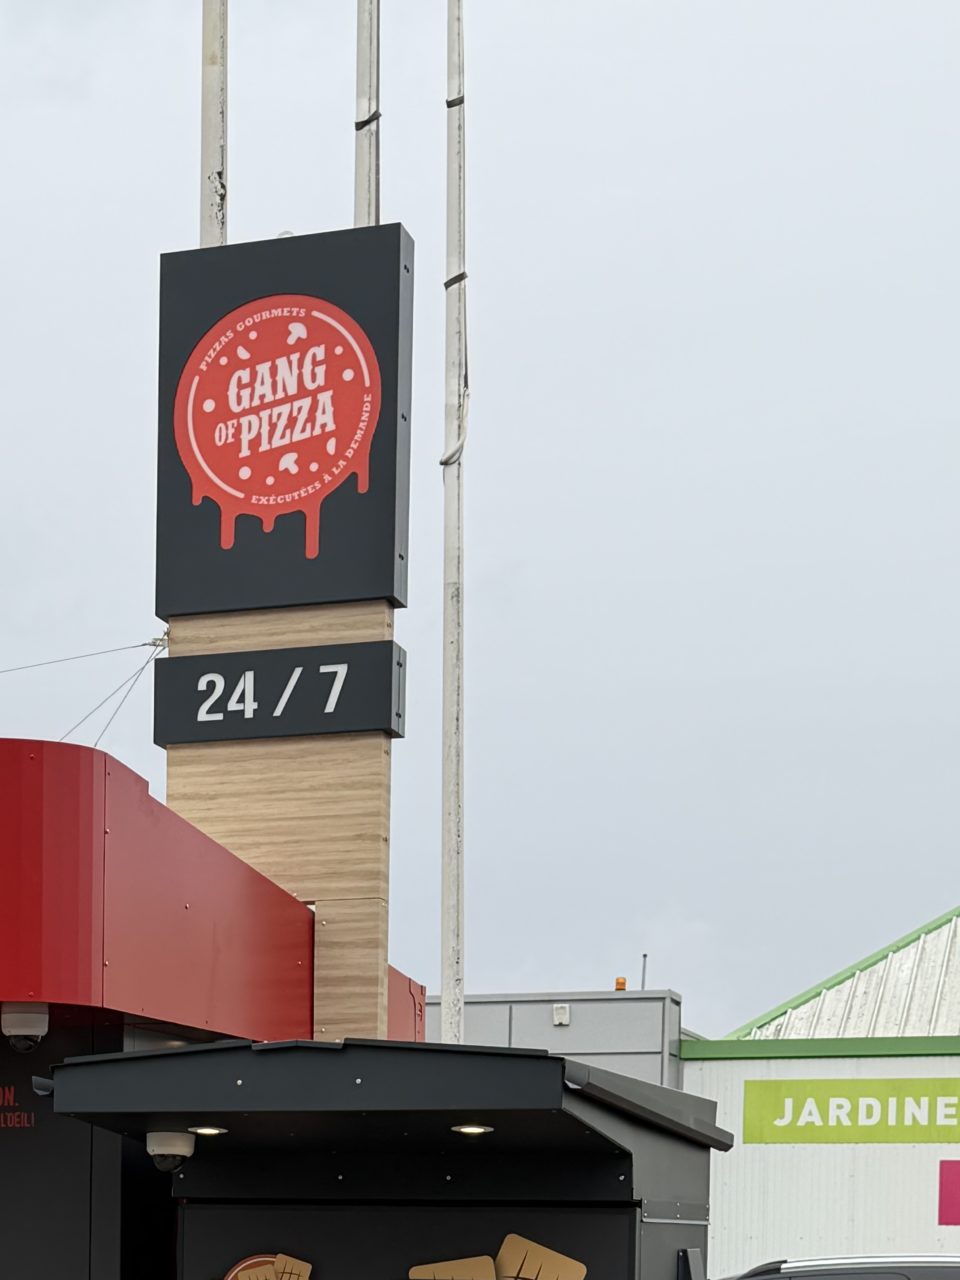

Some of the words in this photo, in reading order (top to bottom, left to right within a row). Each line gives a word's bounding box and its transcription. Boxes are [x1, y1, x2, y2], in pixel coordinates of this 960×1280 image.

[199, 330, 234, 371] PIZZAS
[236, 307, 306, 331] GOURMETS
[227, 343, 326, 413] GANG
[214, 418, 238, 447] OF
[239, 389, 336, 459] PIZZA
[332, 459, 347, 475] LA
[345, 393, 372, 459] DEMANDE
[197, 670, 258, 722] 24
[319, 663, 348, 713] 7
[773, 1096, 959, 1126] JARDINE
